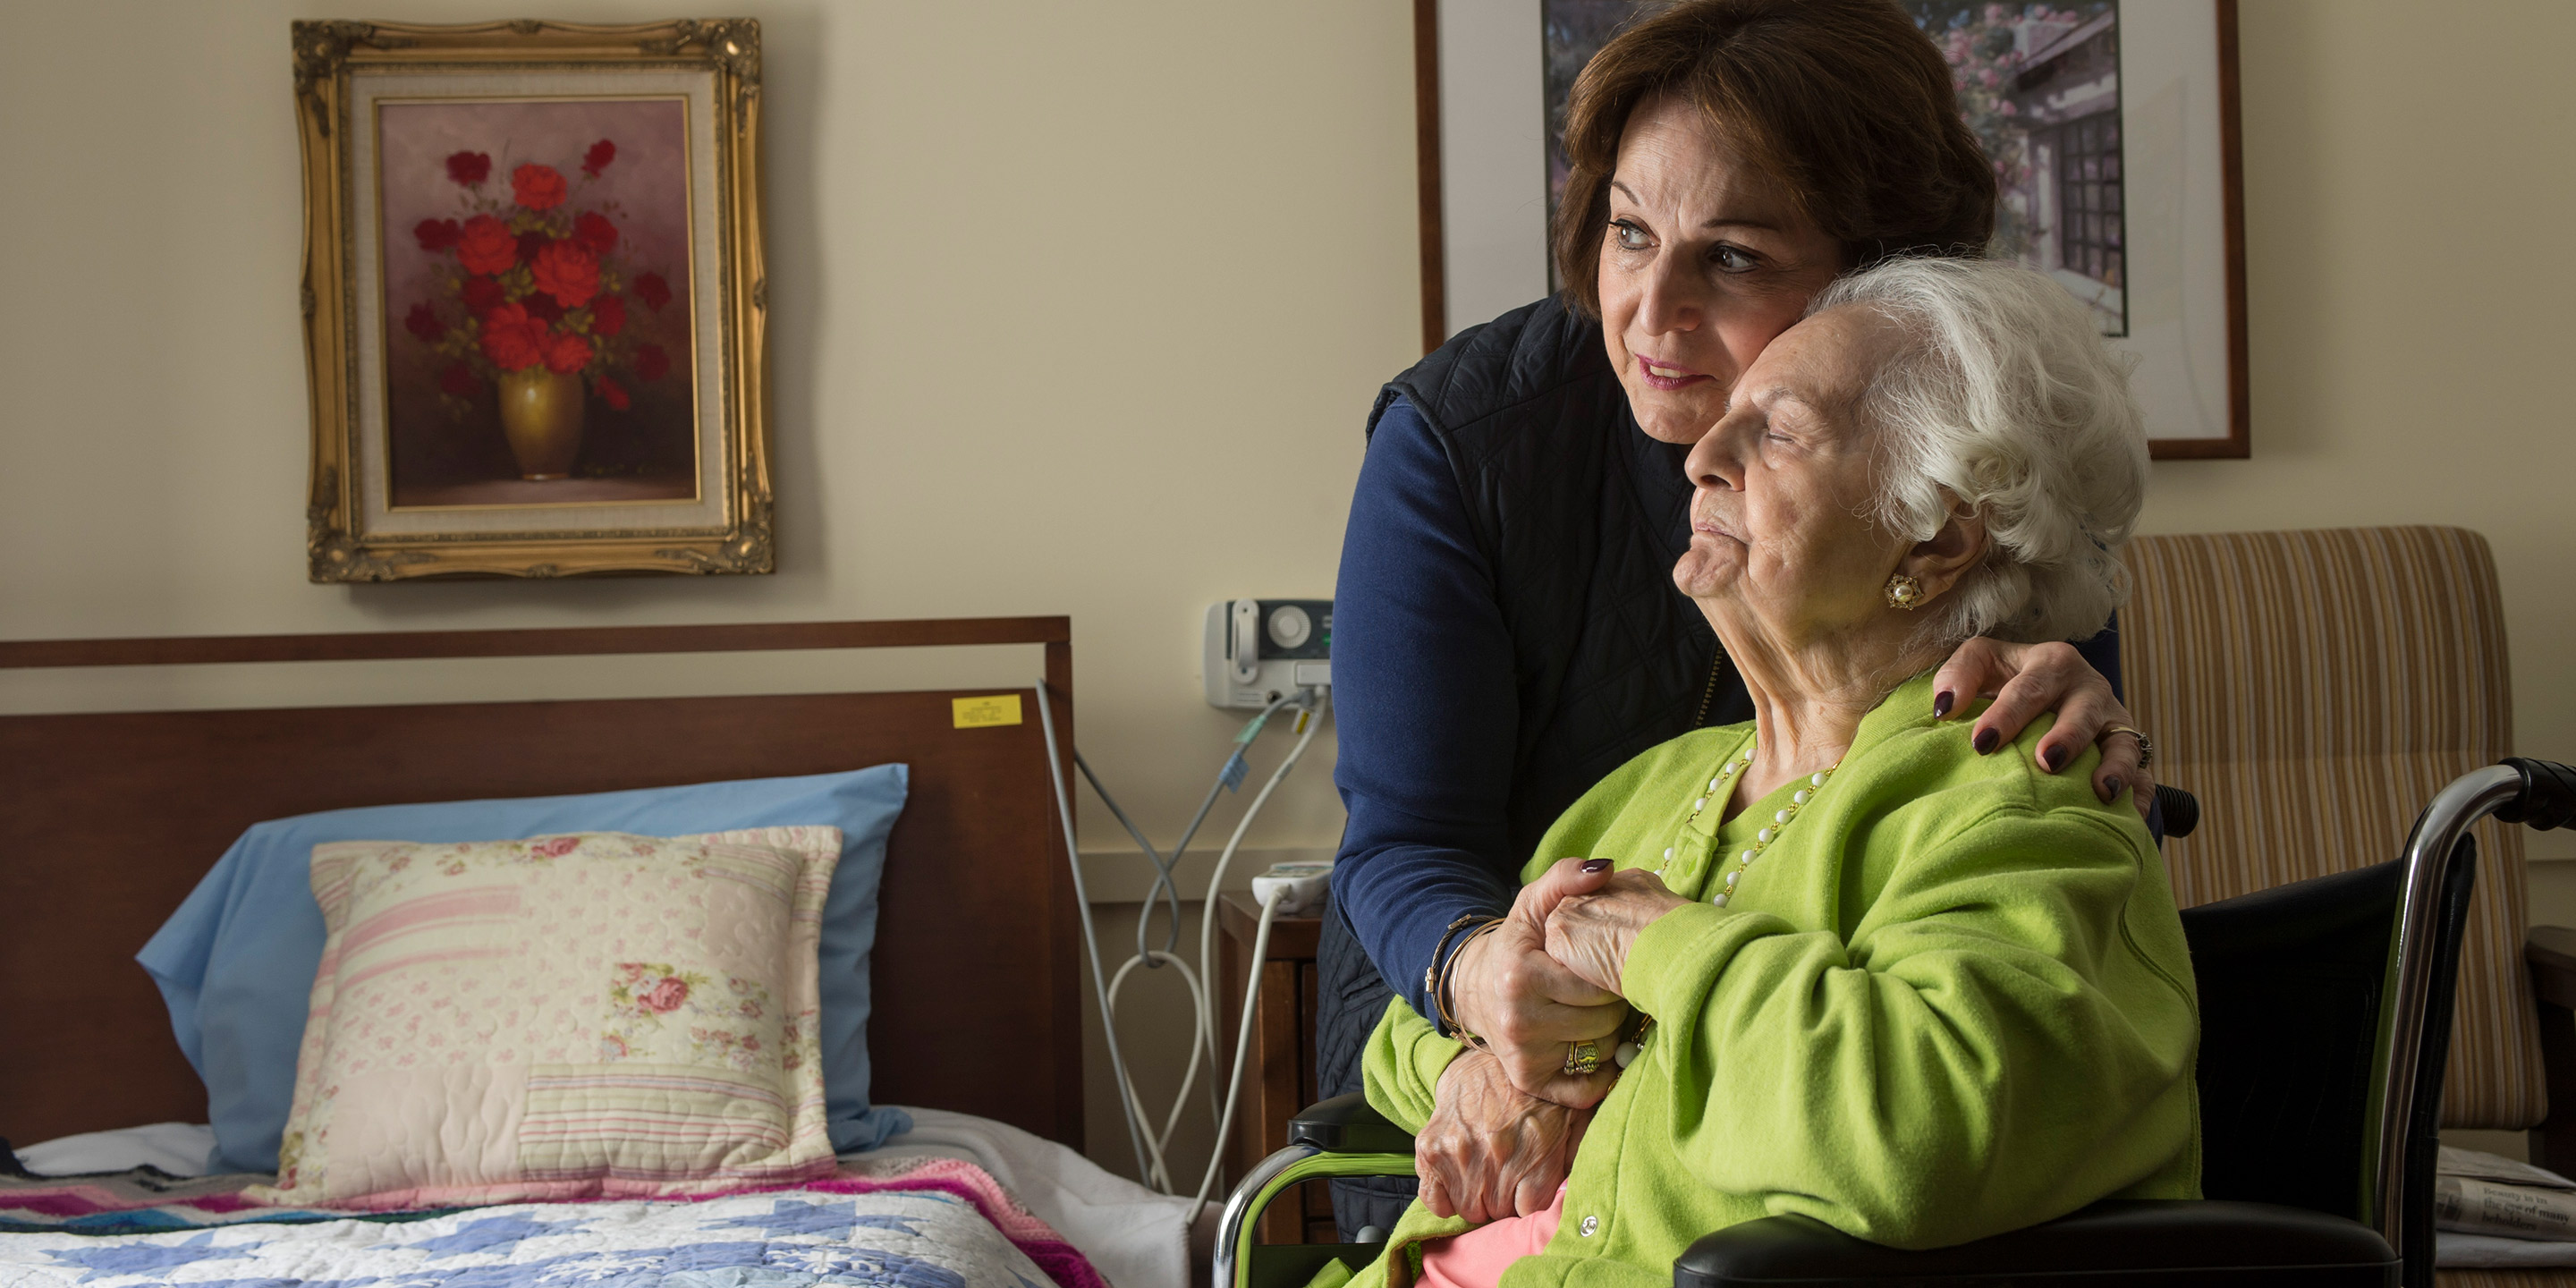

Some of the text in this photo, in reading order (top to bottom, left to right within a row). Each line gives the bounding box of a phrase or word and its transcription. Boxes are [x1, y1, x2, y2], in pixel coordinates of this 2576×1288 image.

[2484, 1187, 2521, 1201] Beauty
[2482, 1210, 2538, 1231] beholders
[2484, 1197, 2571, 1225] the eye of many
